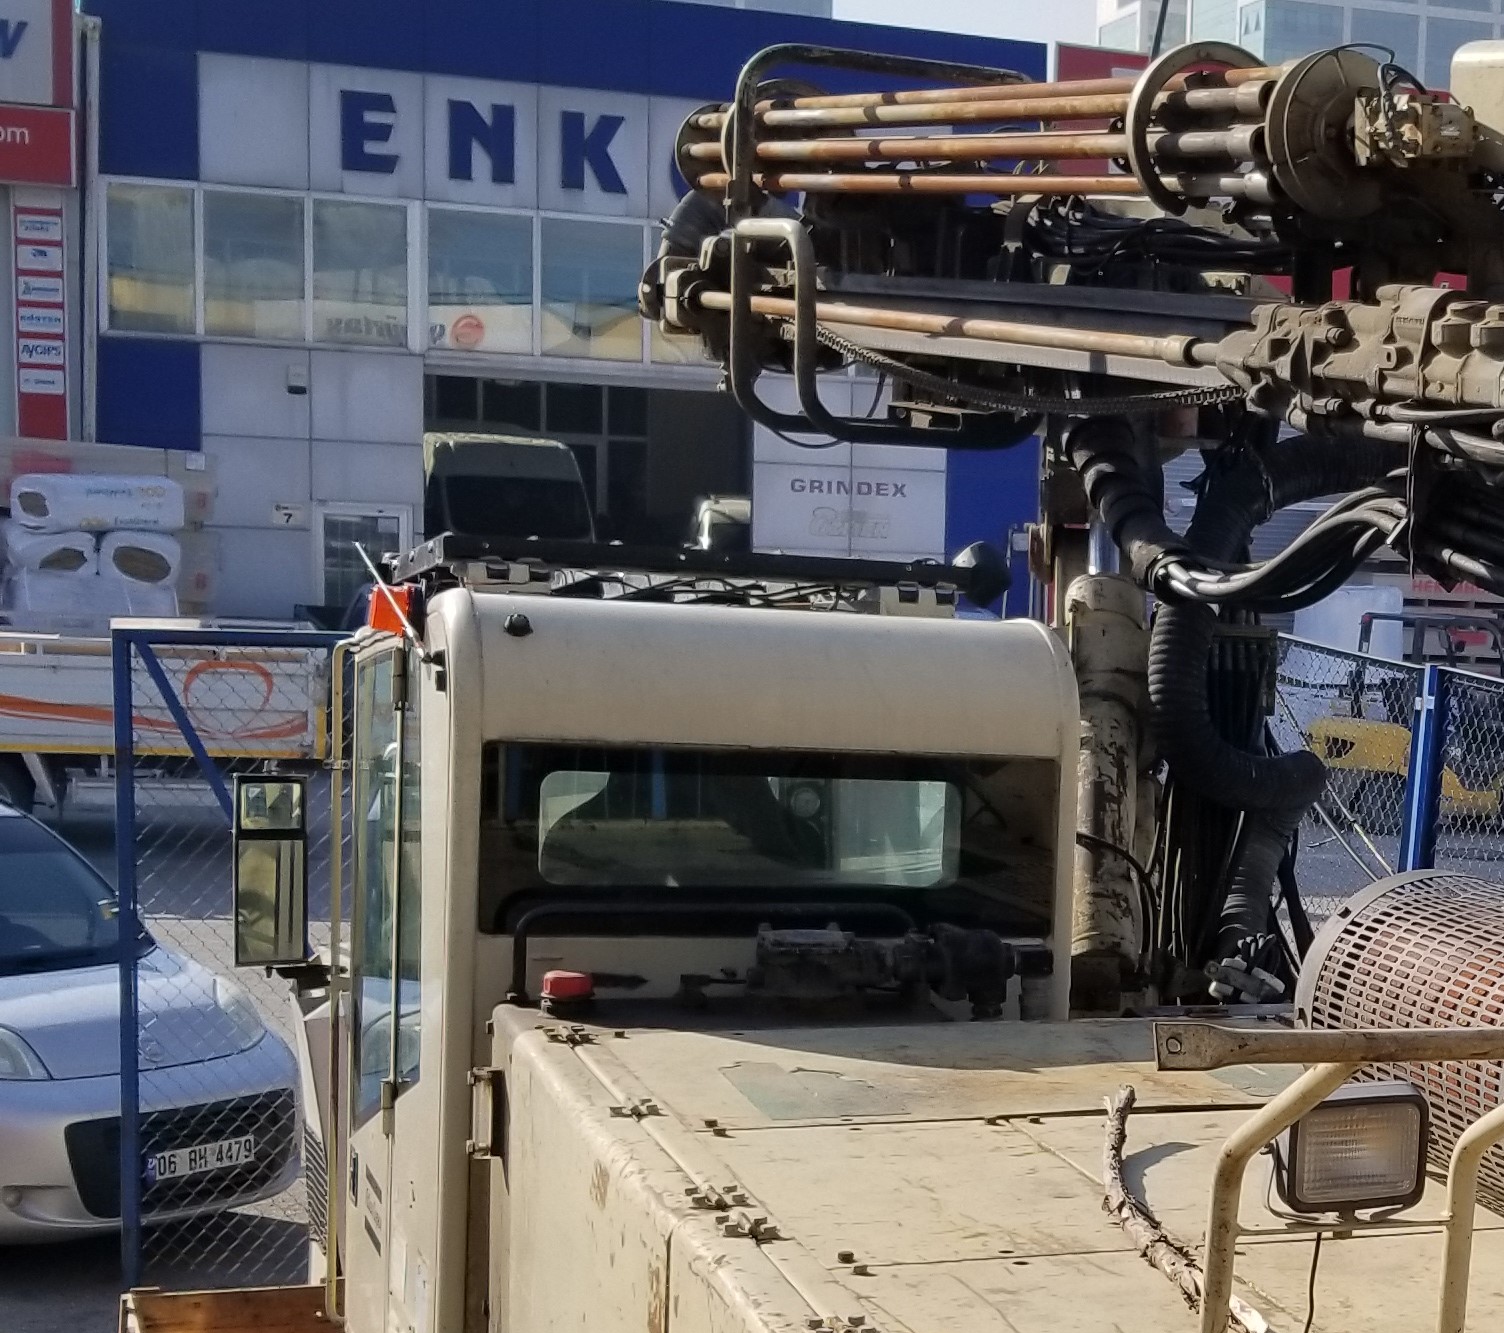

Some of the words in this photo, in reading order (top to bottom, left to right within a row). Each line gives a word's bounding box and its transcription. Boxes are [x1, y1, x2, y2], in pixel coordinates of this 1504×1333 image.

[340, 89, 692, 200] ENK
[790, 478, 907, 498] GRINDEX
[283, 512, 293, 524] 7
[157, 1153, 177, 1176] 06
[216, 1139, 253, 1163] 4479
